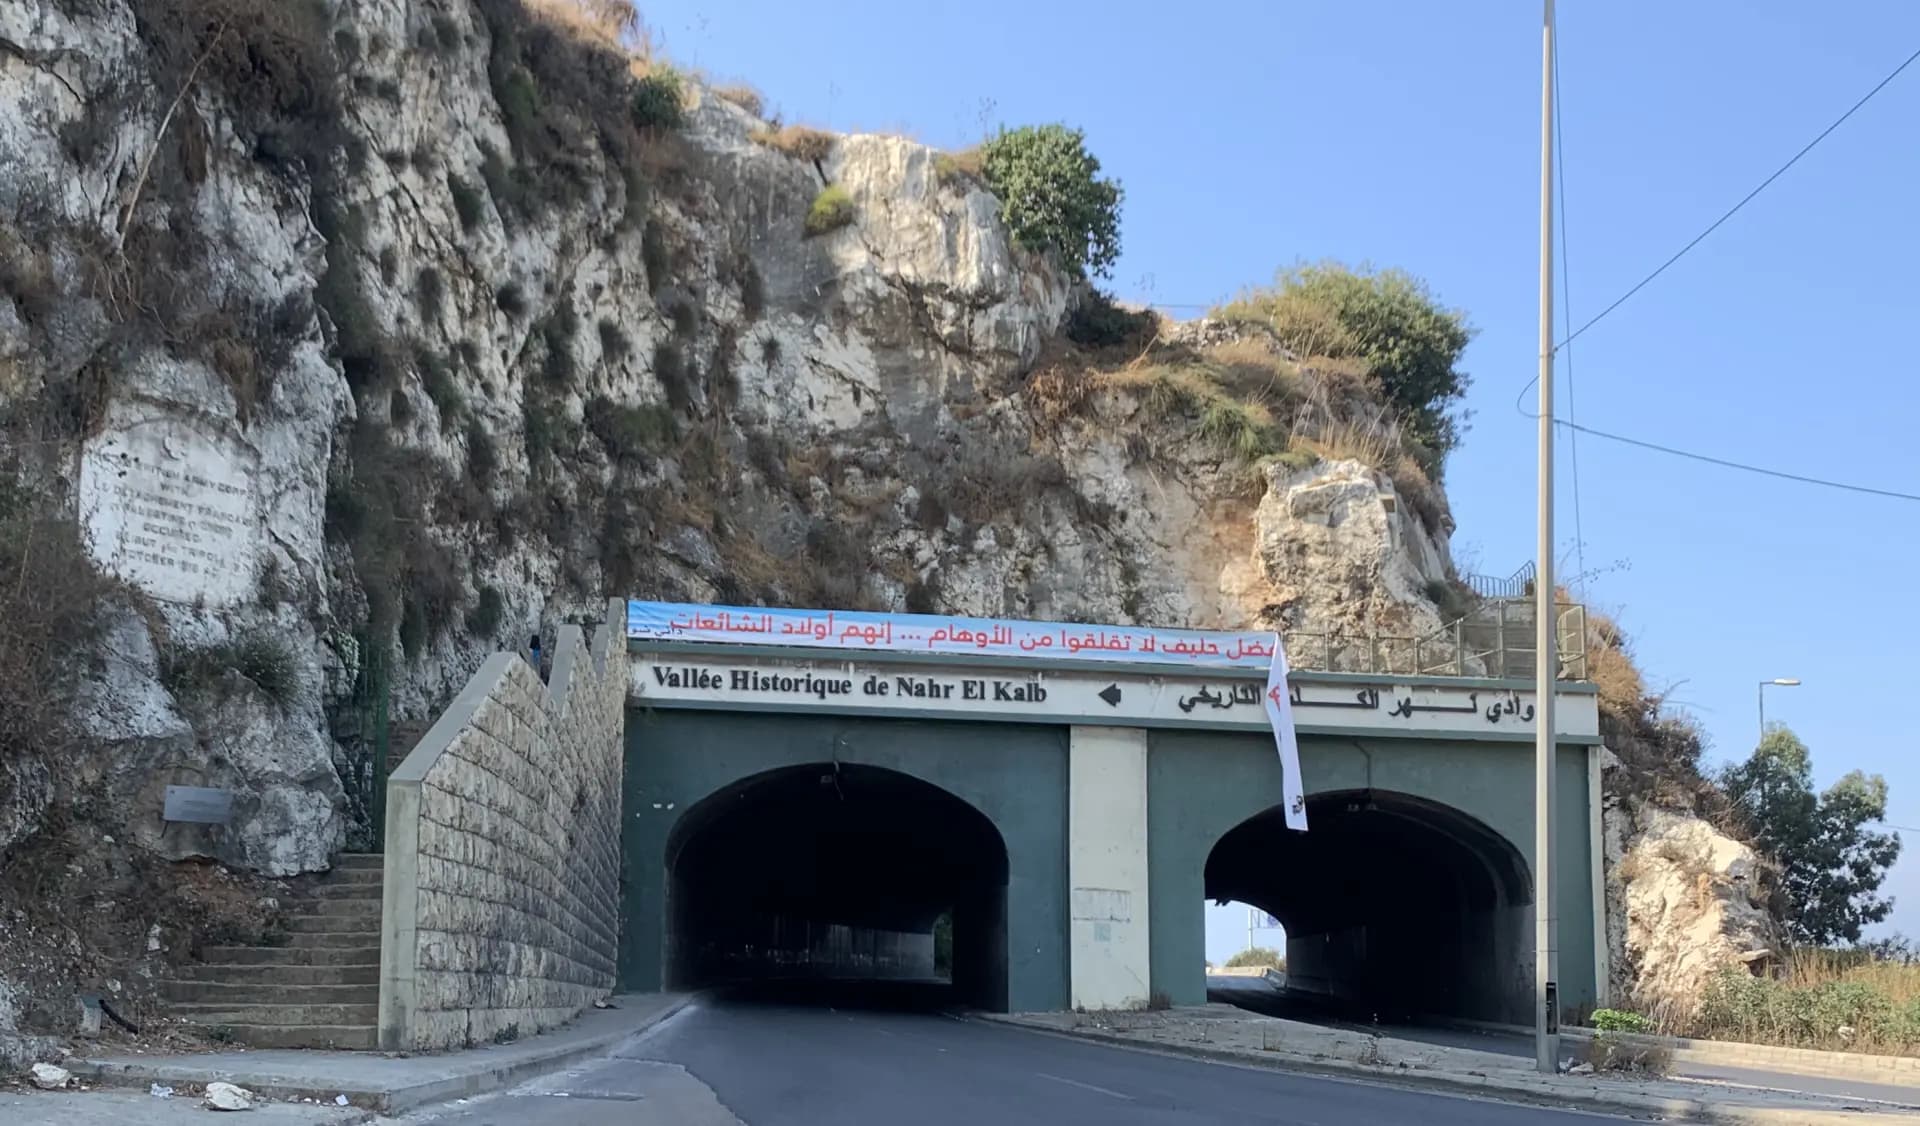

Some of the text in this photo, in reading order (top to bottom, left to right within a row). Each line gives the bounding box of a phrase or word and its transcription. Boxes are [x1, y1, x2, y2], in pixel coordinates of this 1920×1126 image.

[840, 621, 891, 645] إنهم
[928, 624, 1012, 648] الأوهام
[1020, 633, 1052, 650] من
[1061, 630, 1131, 653] تقلقوا
[1139, 635, 1155, 652] لا
[1162, 637, 1219, 658] حليف
[652, 666, 1048, 703] Vallée Historique de Nahr El Kalb
[1486, 695, 1535, 724] وادي
